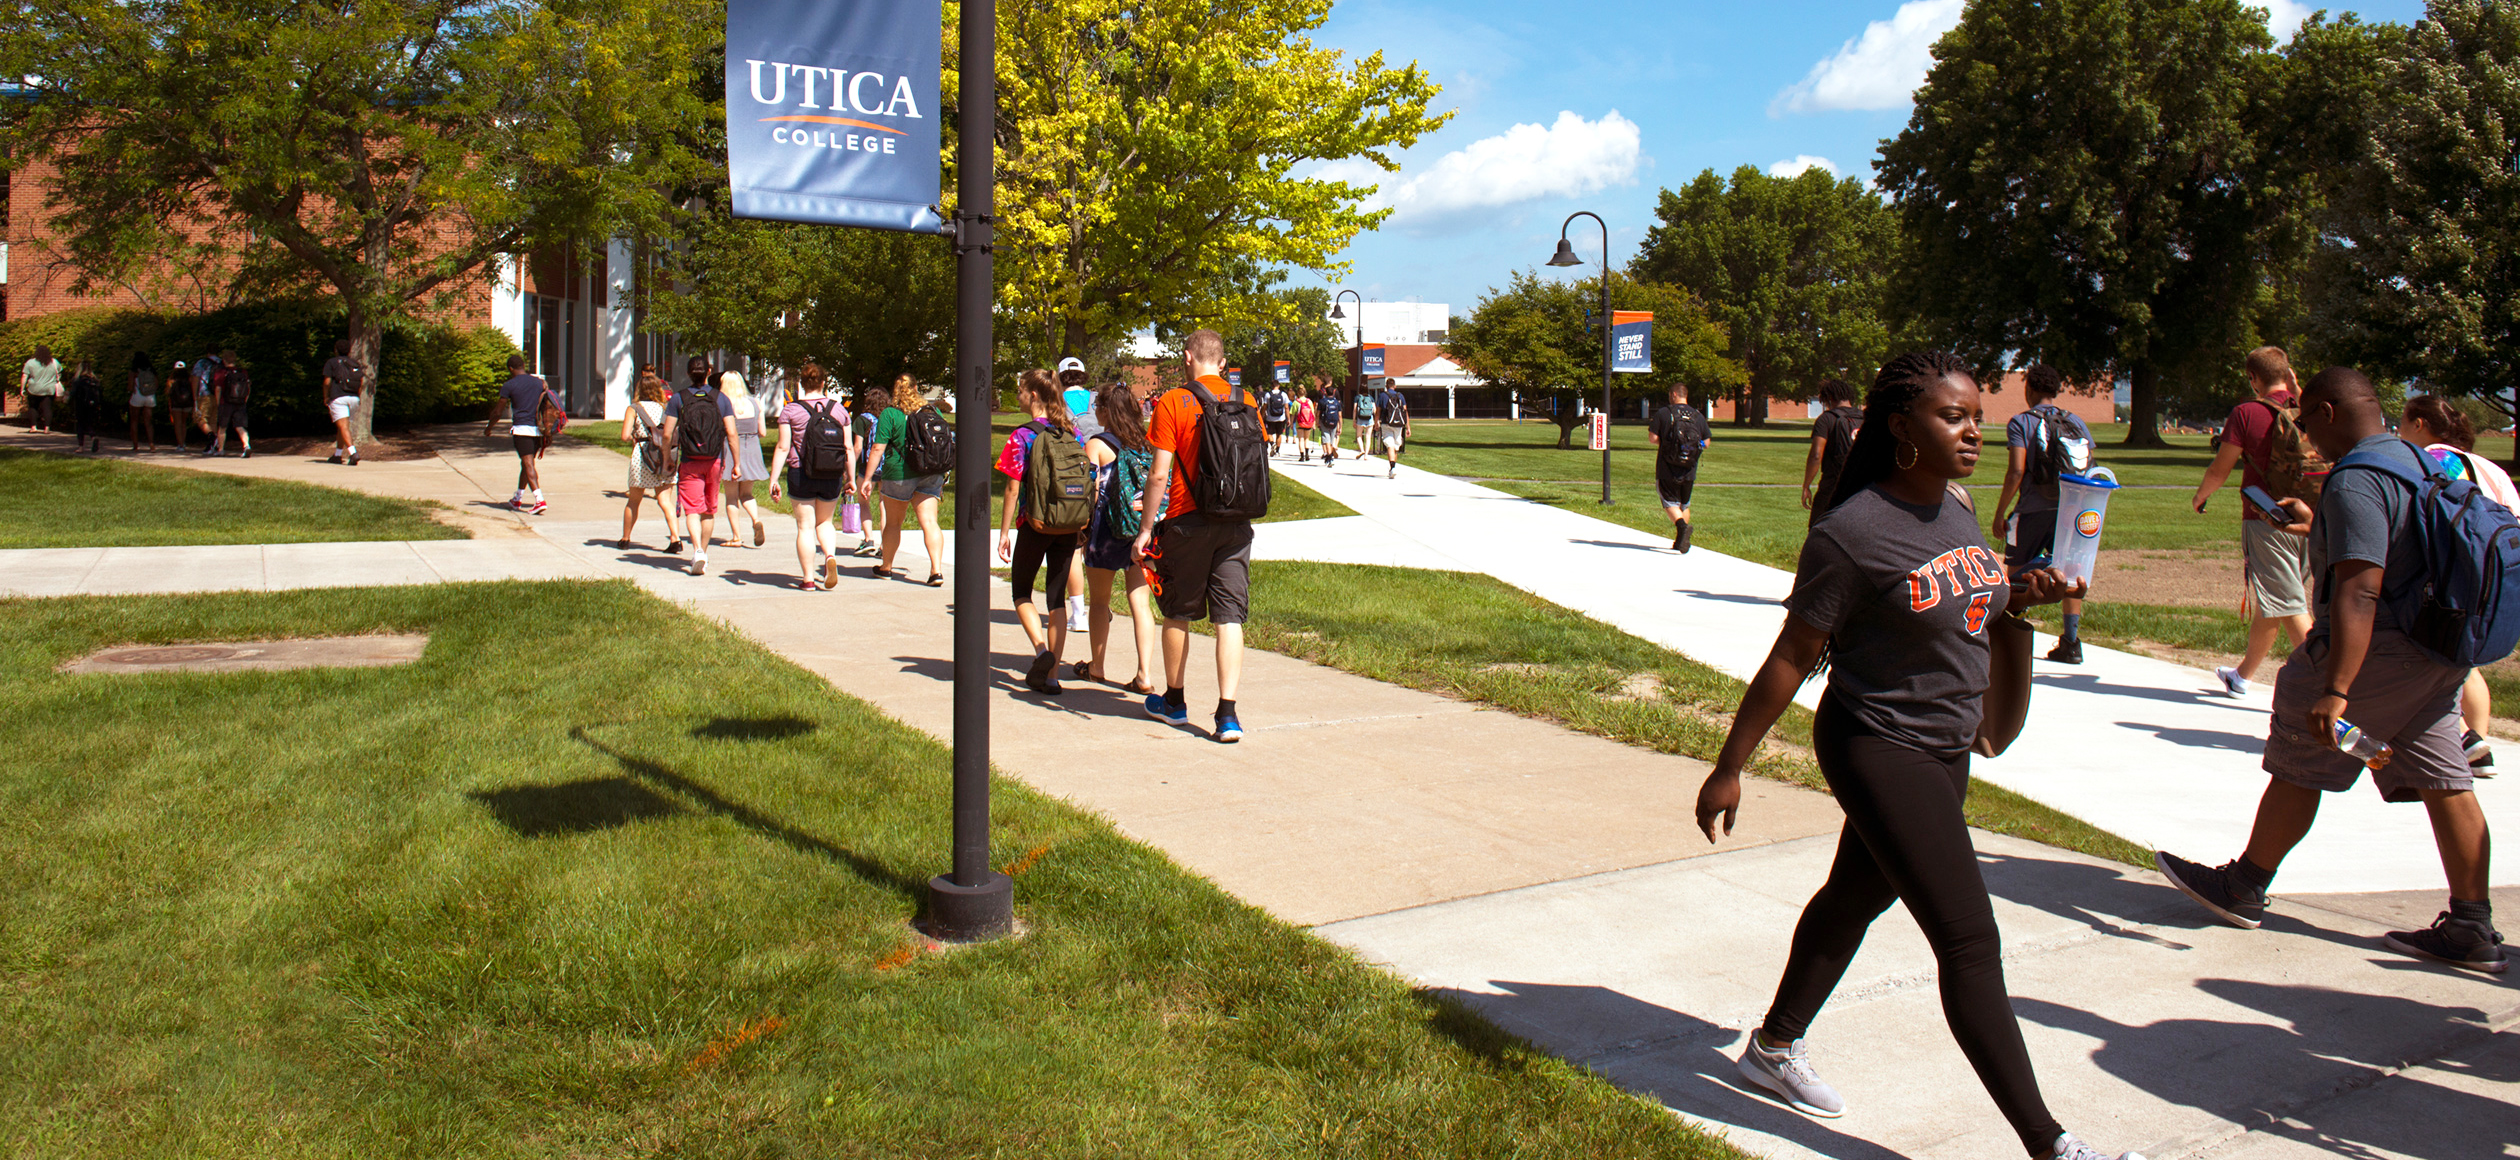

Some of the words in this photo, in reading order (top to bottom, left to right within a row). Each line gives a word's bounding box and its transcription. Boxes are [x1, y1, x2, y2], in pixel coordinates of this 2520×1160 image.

[746, 59, 923, 119] UTICA
[772, 127, 896, 154] COLLEGE
[1618, 334, 1644, 344] NEVER
[1618, 342, 1643, 352] STAND
[1618, 350, 1643, 361] STILL
[2080, 515, 2096, 523] DAVE
